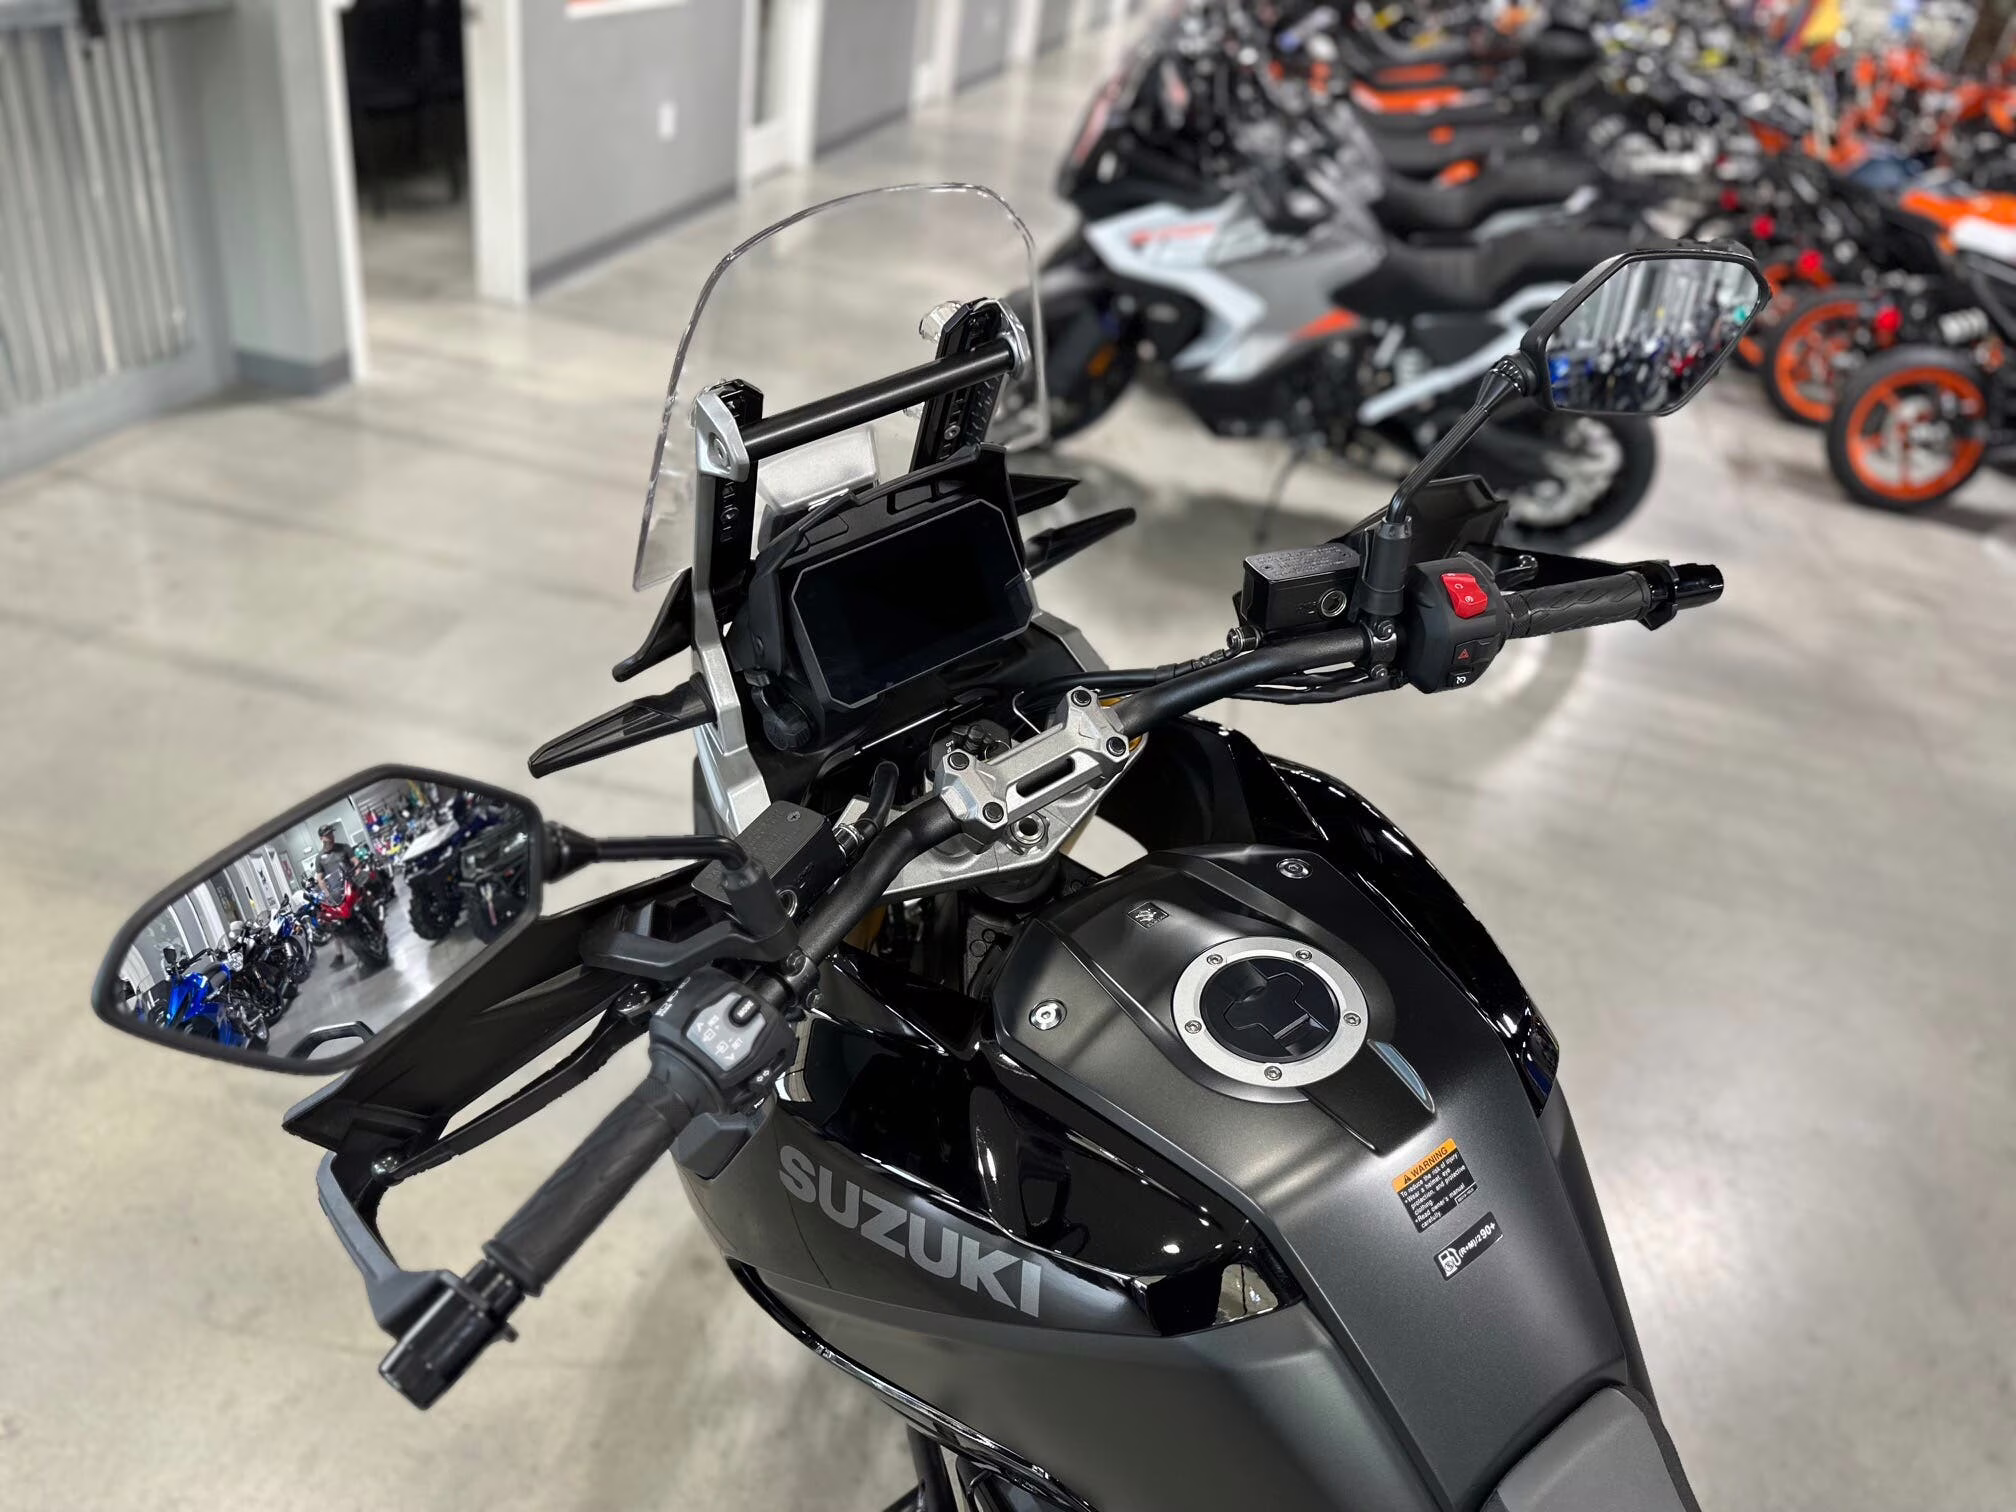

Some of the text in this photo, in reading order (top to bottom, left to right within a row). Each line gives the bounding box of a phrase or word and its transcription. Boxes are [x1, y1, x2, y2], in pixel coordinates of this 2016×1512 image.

[737, 1000, 754, 1018] MODE
[1410, 1146, 1448, 1177] WARNING
[1441, 1167, 1451, 1178] eye
[1400, 1191, 1408, 1199] To
[1408, 1179, 1423, 1193] reduce
[1423, 1173, 1431, 1182] the
[1435, 1180, 1445, 1191] and
[1444, 1164, 1466, 1185] protective
[1418, 1209, 1431, 1222] Read
[1449, 1182, 1466, 1198] manual
[779, 1145, 1042, 1318] SUZUKI
[1480, 1222, 1496, 1239] 90+
